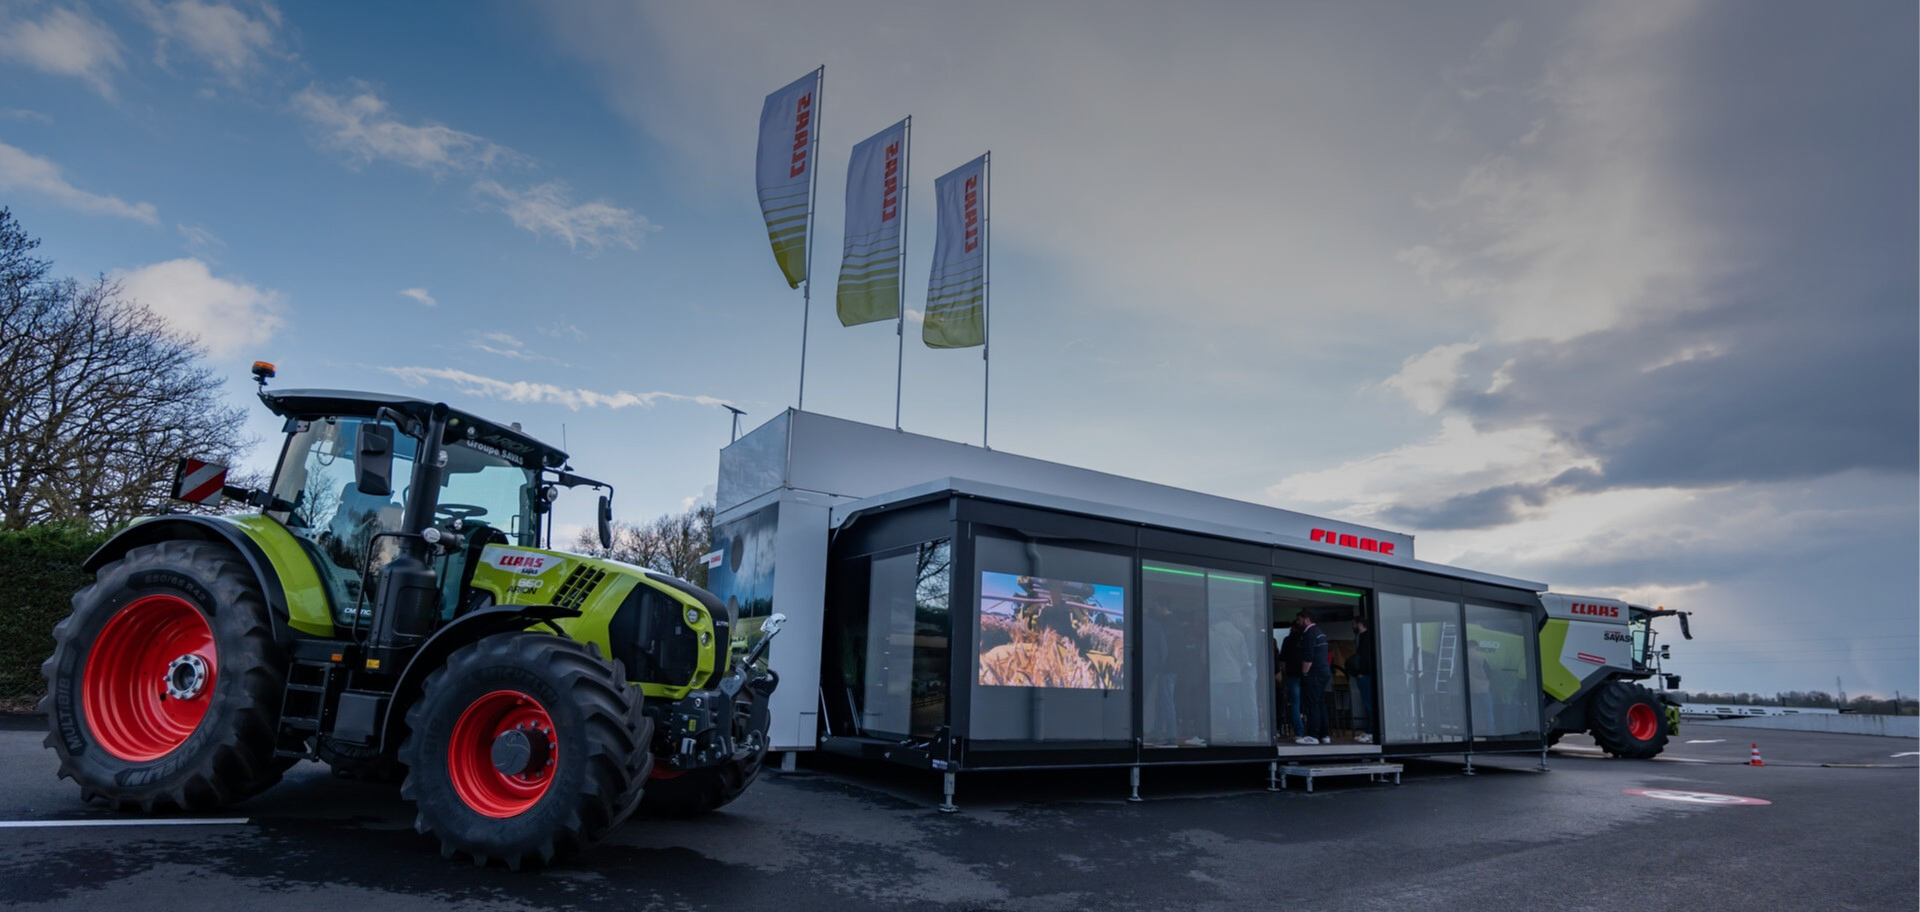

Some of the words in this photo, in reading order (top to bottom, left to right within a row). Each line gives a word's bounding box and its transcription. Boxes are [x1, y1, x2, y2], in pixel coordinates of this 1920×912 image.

[466, 438, 500, 457] Groupe
[501, 449, 524, 466] SAVAS
[499, 555, 544, 568] CLAAS
[506, 585, 537, 595] ARION
[344, 607, 372, 616] CMTIC
[1571, 602, 1619, 618] CLAAS
[1603, 632, 1631, 643] SAVAS
[57, 676, 83, 751] MULTIBIB
